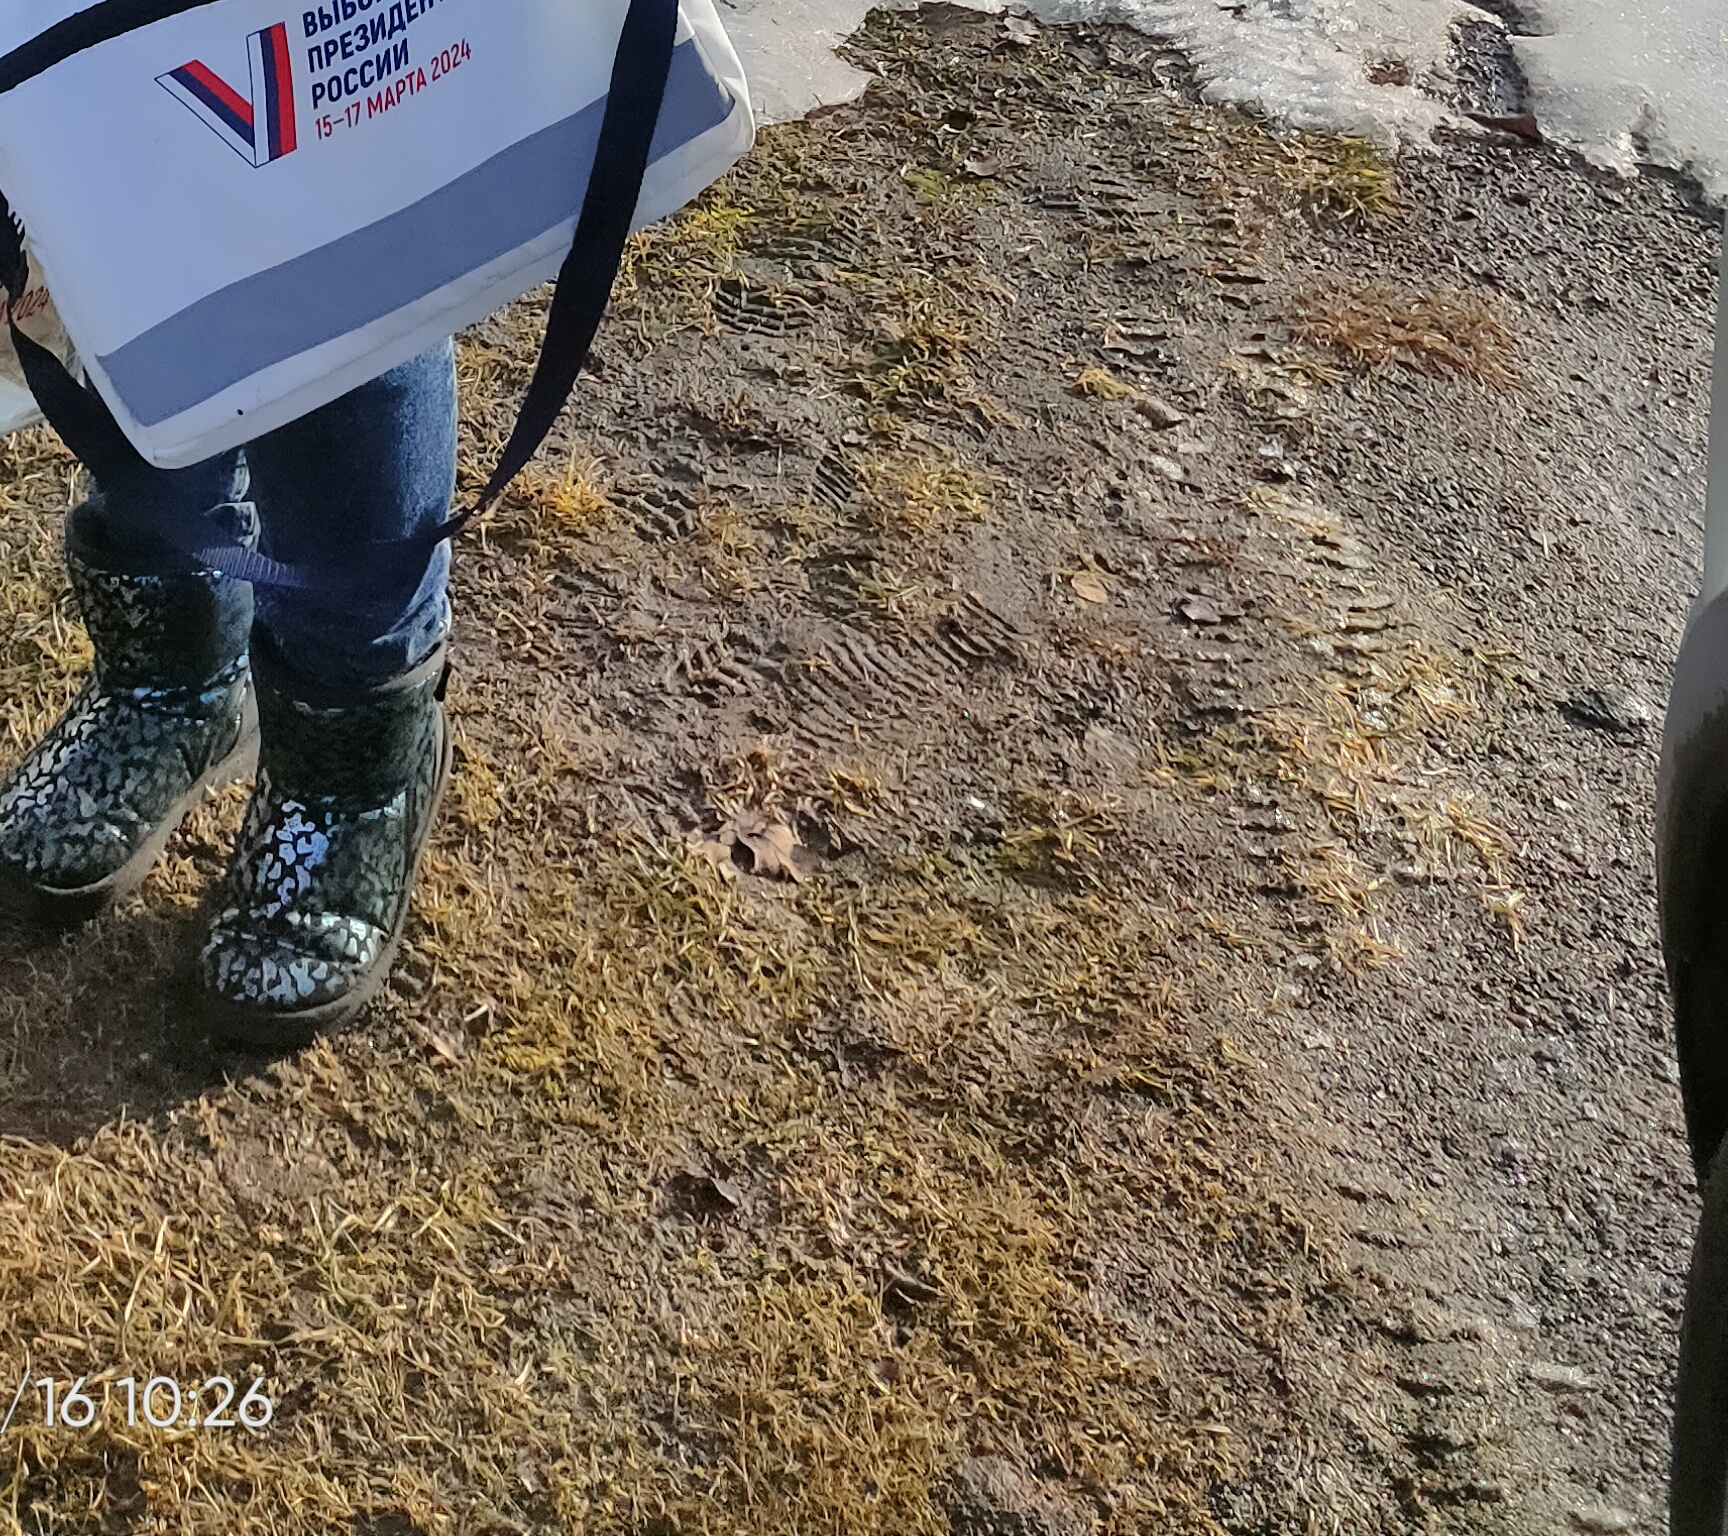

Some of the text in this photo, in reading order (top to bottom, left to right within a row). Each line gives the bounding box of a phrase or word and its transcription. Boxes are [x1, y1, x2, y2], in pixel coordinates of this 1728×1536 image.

[311, 37, 409, 110] РОССИИ
[367, 67, 427, 119] МАРТА
[430, 38, 471, 82] 2024
